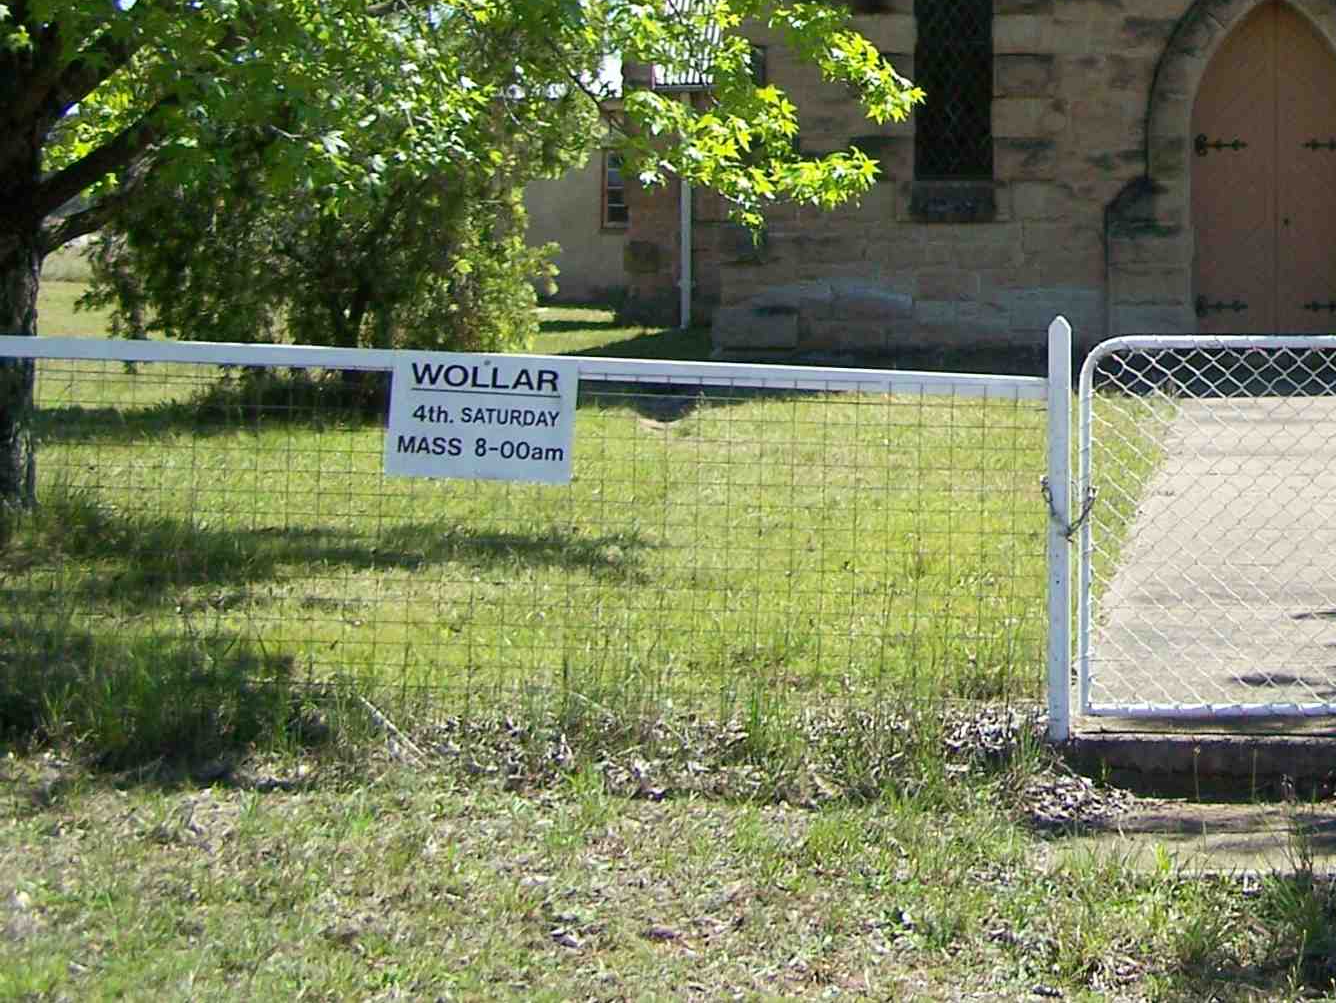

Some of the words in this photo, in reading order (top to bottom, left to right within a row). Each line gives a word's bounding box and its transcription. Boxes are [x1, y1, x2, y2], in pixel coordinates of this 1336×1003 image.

[411, 362, 559, 392] WOLLAR
[412, 404, 455, 424] 4th.
[460, 407, 560, 427] SATURDAY
[396, 435, 462, 457] MASS
[473, 437, 564, 462] 8-00am
